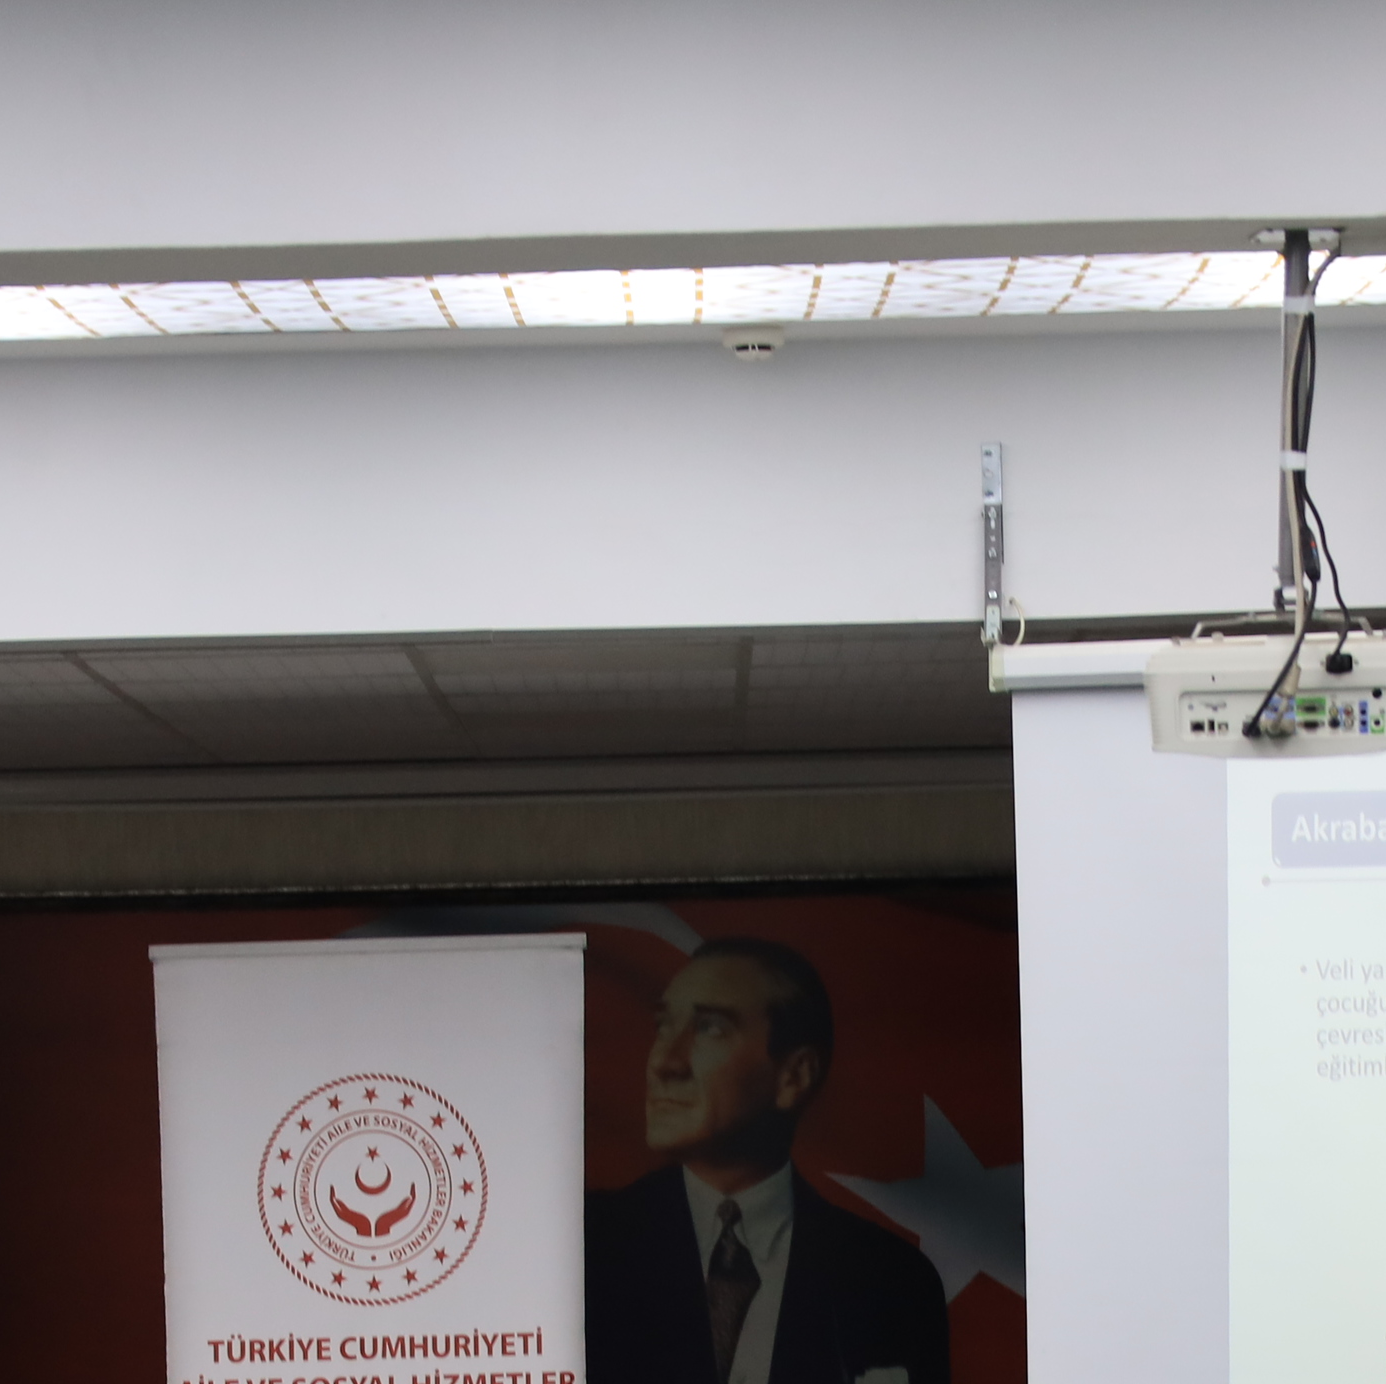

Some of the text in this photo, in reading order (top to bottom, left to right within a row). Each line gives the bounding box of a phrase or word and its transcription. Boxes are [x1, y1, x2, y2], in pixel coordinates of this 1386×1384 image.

[1316, 959, 1353, 980] Veli
[1361, 964, 1385, 985] ya
[327, 1118, 352, 1142] AİLE
[353, 1116, 370, 1128] VE
[373, 1116, 420, 1141] SOSYAL
[311, 1224, 355, 1262] TÜRKİYE
[207, 1327, 543, 1364] TÜRKİYE CUMHURİYETİ
